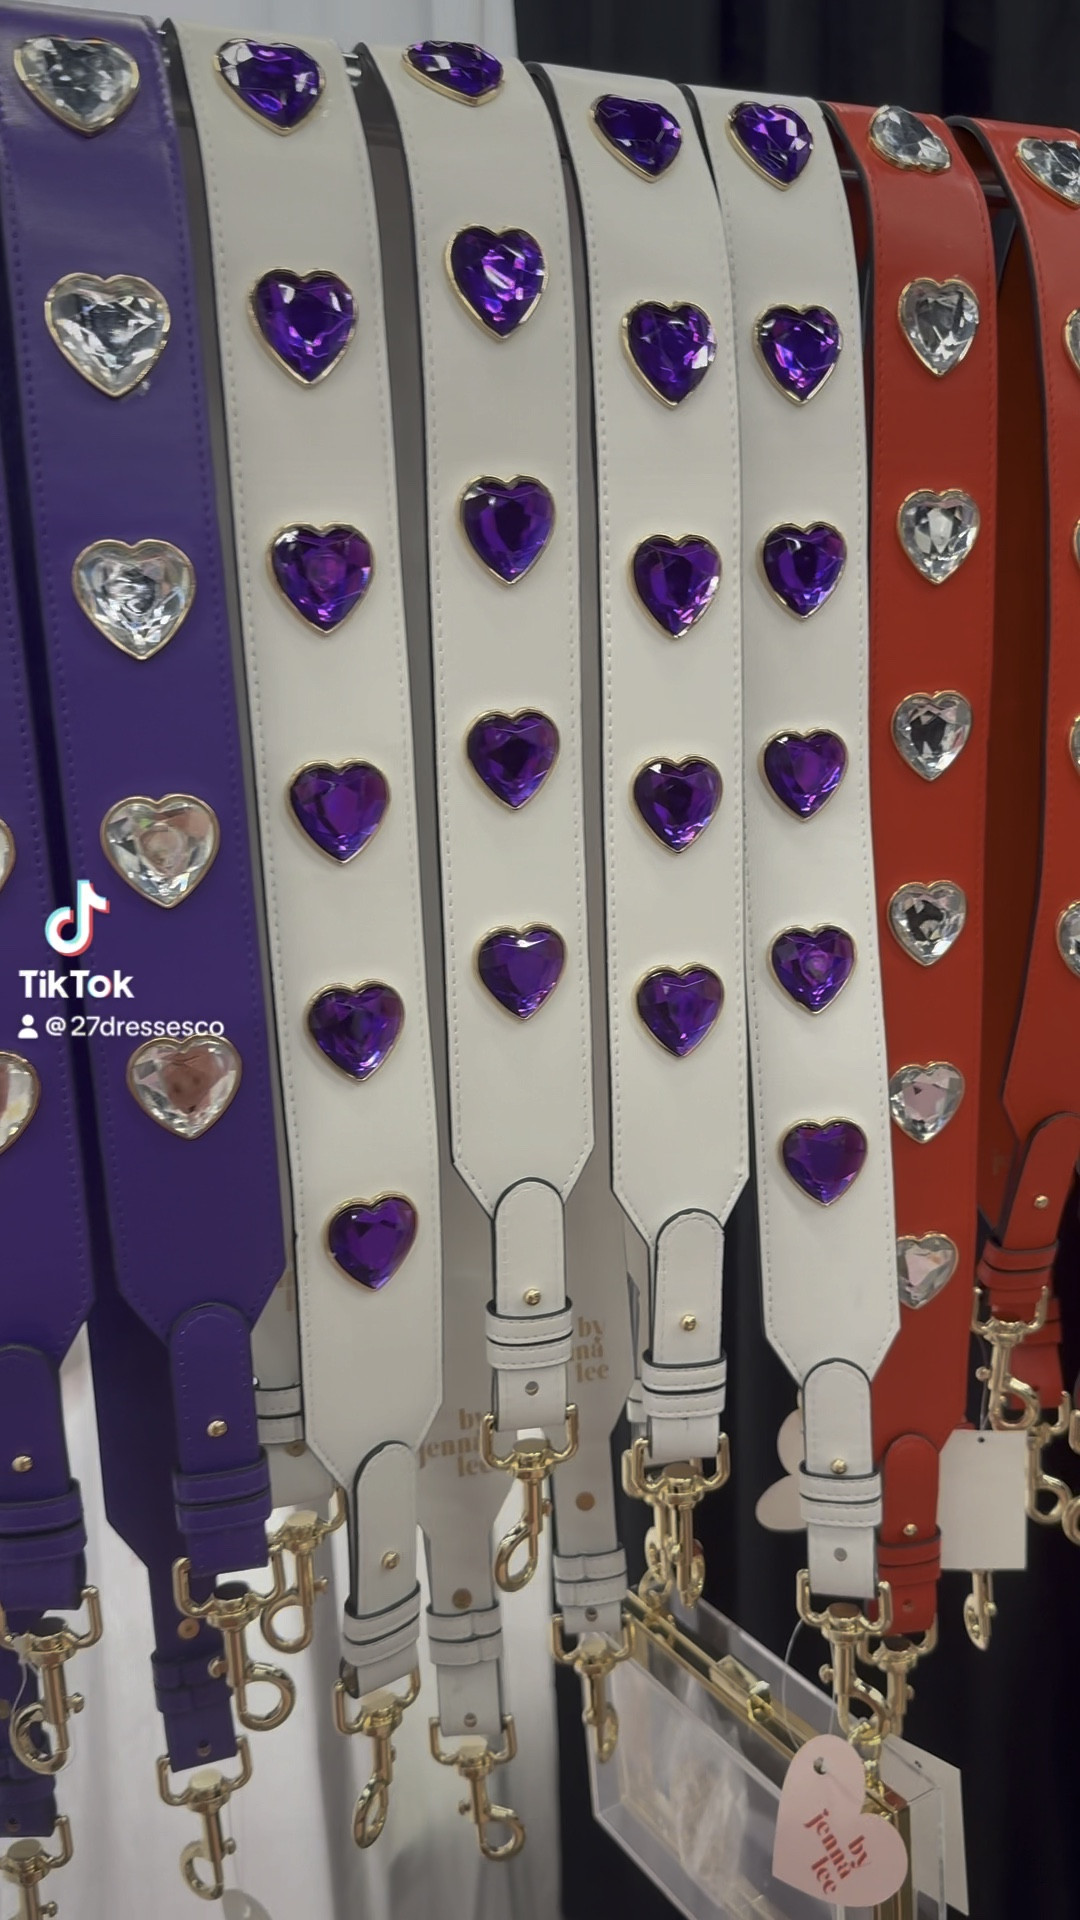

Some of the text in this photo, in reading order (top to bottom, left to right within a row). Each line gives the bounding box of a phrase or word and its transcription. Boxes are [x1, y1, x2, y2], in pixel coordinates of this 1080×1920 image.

[577, 1316, 605, 1342] by
[575, 1363, 609, 1383] lee
[804, 1808, 851, 1880] jenna
[848, 1835, 868, 1869] by
[811, 1855, 837, 1895] lee
